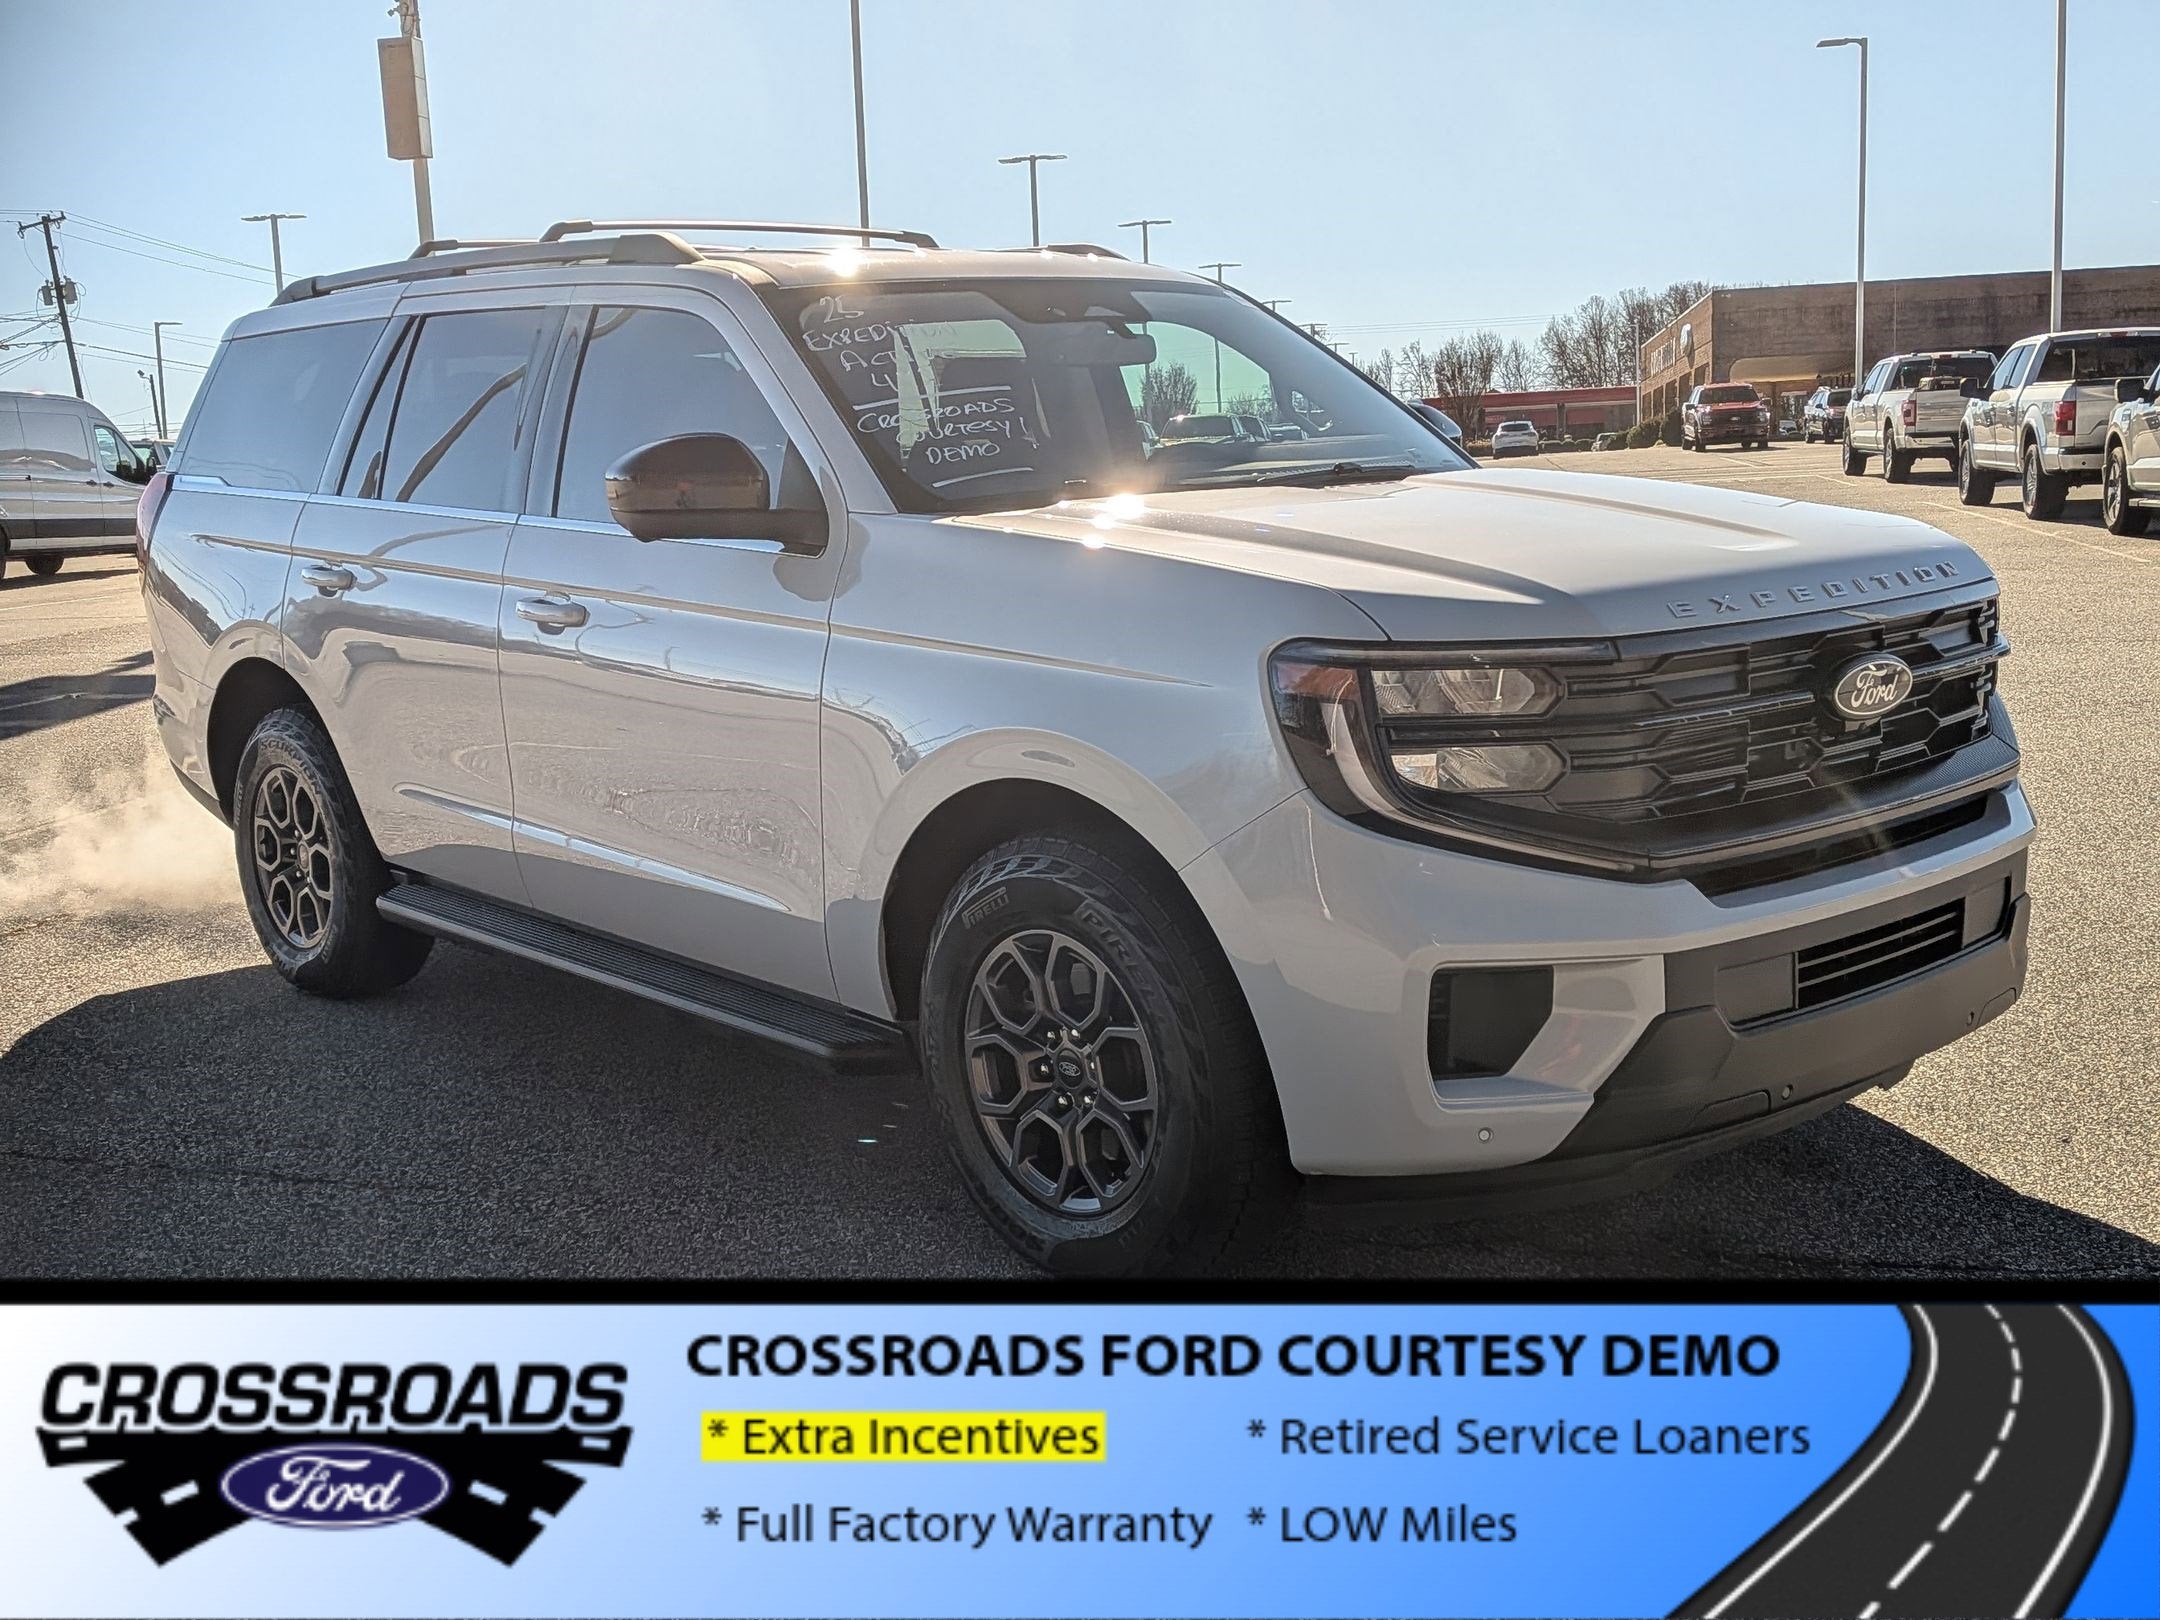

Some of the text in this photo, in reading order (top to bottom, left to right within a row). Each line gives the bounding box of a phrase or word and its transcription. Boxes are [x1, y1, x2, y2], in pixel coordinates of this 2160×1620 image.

[857, 398, 1016, 433] CROSROADS
[926, 441, 1000, 464] DEMO
[1666, 561, 1960, 619] EXPEDITION
[1850, 663, 1902, 708] Ford
[962, 886, 1009, 929] PIRELLI
